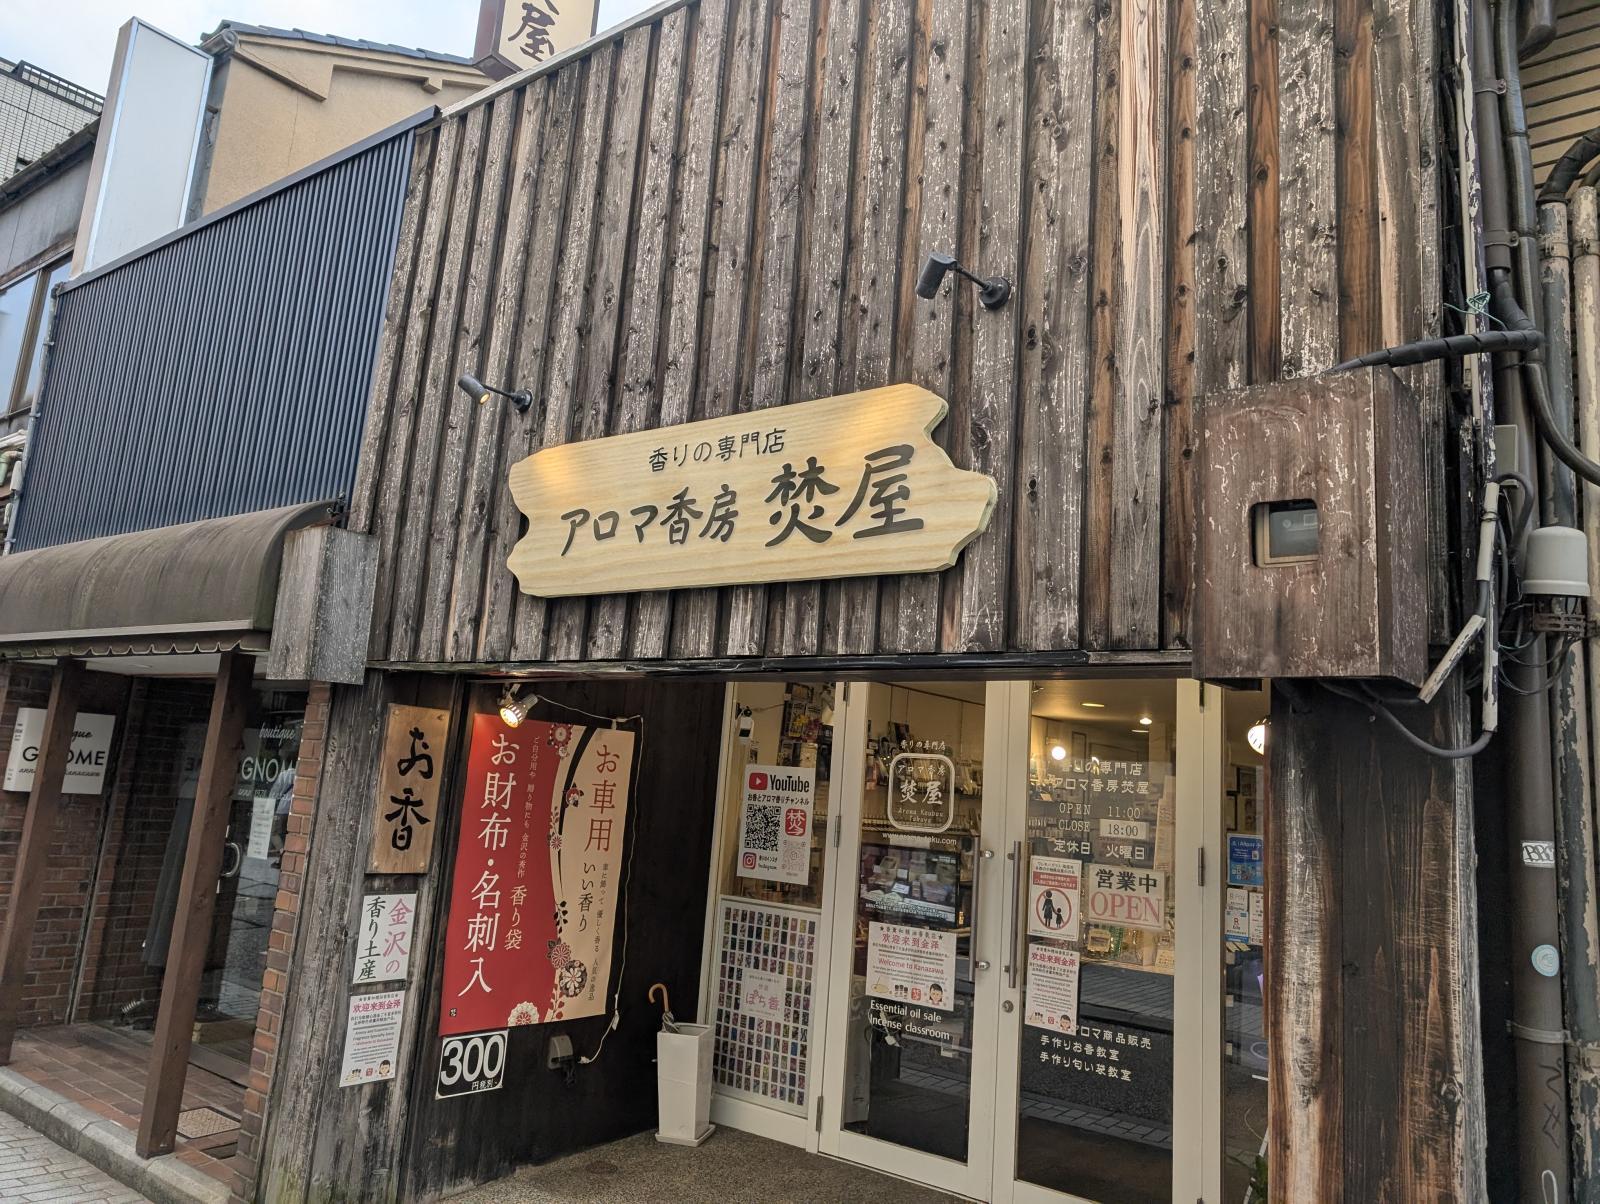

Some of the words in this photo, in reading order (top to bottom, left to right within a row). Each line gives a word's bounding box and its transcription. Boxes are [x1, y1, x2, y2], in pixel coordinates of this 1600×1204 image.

[648, 428, 787, 472] 香りの専門店
[560, 482, 739, 557] アロマ香房
[764, 443, 924, 548] 焚屋
[260, 722, 296, 746] boutique
[900, 739, 946, 751] 香りの専門店
[384, 727, 434, 850] お香
[769, 774, 810, 793] YouTube
[900, 779, 943, 805] 焚屋
[1054, 779, 1150, 794] アロマ香房焚屋
[584, 744, 620, 852] お車用
[1059, 802, 1092, 815] OPEN
[1107, 806, 1141, 819] 11:00
[1058, 820, 1091, 832] CLOSE
[1108, 823, 1139, 837] 18:00
[1054, 839, 1091, 855] 定休日
[1105, 844, 1145, 860] 火曜日
[457, 733, 520, 997] お財布・名刺入
[1095, 868, 1157, 893] 営業中
[577, 862, 595, 933] いい香り
[1090, 891, 1162, 924] OPEN
[504, 885, 527, 951] 香り袋
[357, 896, 386, 981] 香り土産
[382, 897, 413, 974] 金沢の
[878, 958, 906, 968] Welcome
[913, 963, 944, 975] Kanazawa
[870, 1000, 908, 1016] Essential
[909, 1008, 921, 1019] oil
[923, 1012, 942, 1023] sale
[869, 1014, 902, 1030] Incense
[905, 1022, 950, 1041] classroom
[440, 1034, 504, 1085] 300
[1040, 1035, 1120, 1061] 手作りお香教室
[1039, 1051, 1132, 1082] 手作り匂い袋教室
